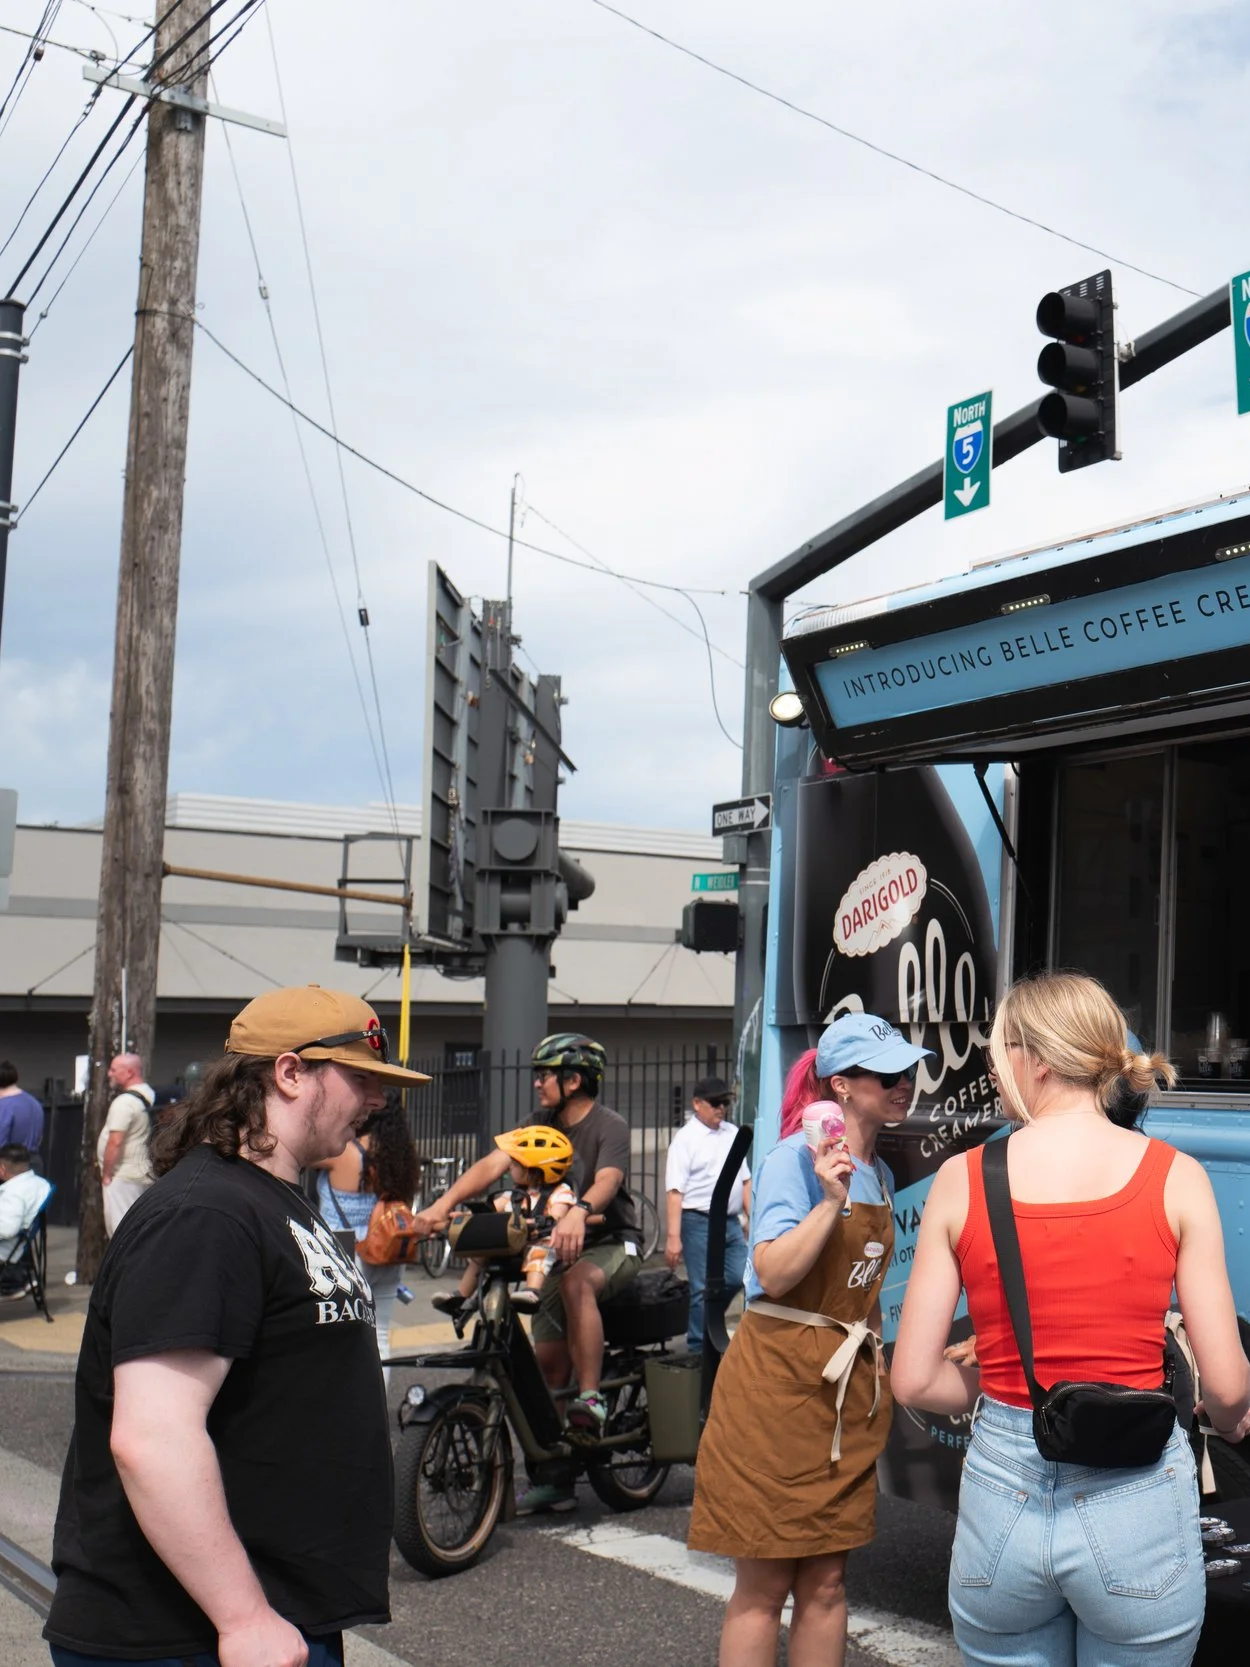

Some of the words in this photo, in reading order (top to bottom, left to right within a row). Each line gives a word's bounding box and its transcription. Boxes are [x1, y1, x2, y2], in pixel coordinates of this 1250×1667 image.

[953, 401, 985, 428] NORTH
[962, 436, 974, 465] 5
[843, 646, 993, 699] INTRODUCING
[999, 626, 1075, 662] BELLE
[1083, 600, 1187, 642] COFFEE
[717, 811, 733, 826] ONE
[738, 807, 755, 823] WAY
[841, 867, 918, 941] DARIGOLD
[931, 1424, 971, 1451] PERFE
